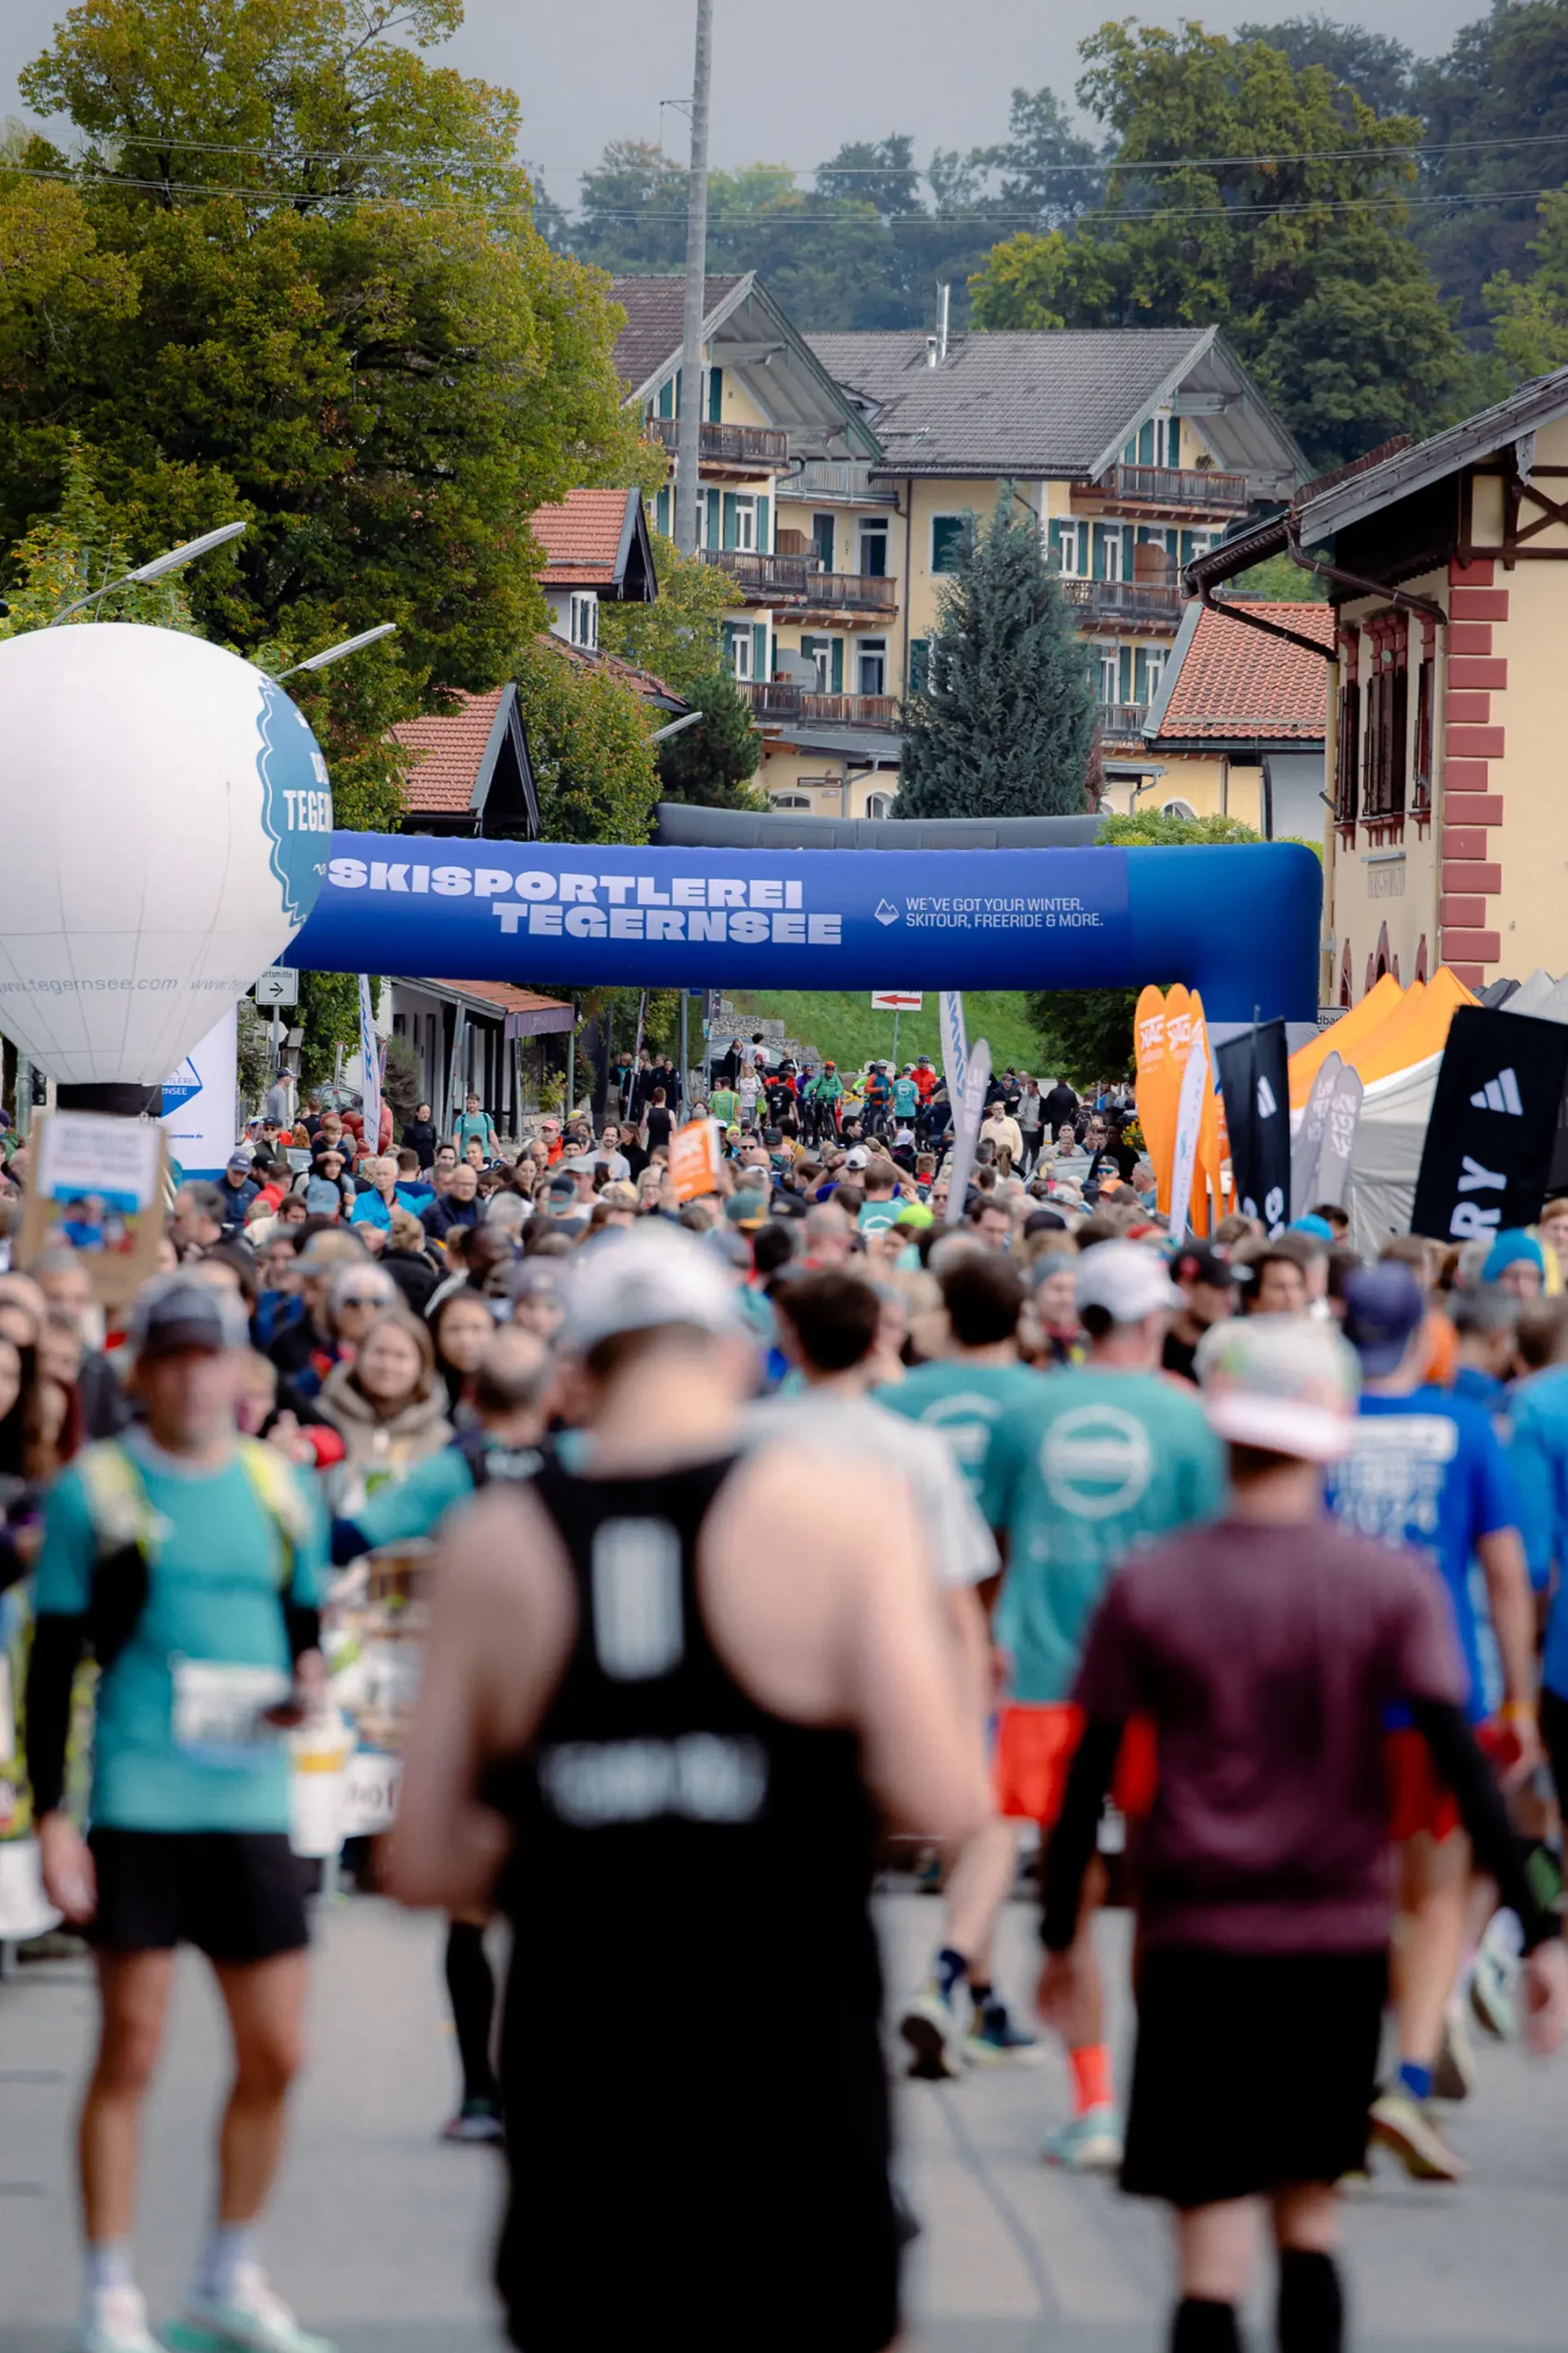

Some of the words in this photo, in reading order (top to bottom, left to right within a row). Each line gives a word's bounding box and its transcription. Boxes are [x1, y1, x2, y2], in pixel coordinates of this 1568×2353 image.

[328, 858, 802, 909] SKISPORTLEREI
[952, 898, 983, 912] GOT
[983, 898, 1026, 912] YOUR
[1026, 897, 1085, 911] WINTER.
[492, 902, 842, 945] TEGERNSEE
[905, 914, 971, 929] SKITOUR,
[974, 914, 1043, 927] FREERIDE
[1045, 914, 1056, 927] &
[1059, 913, 1104, 927] MORE.
